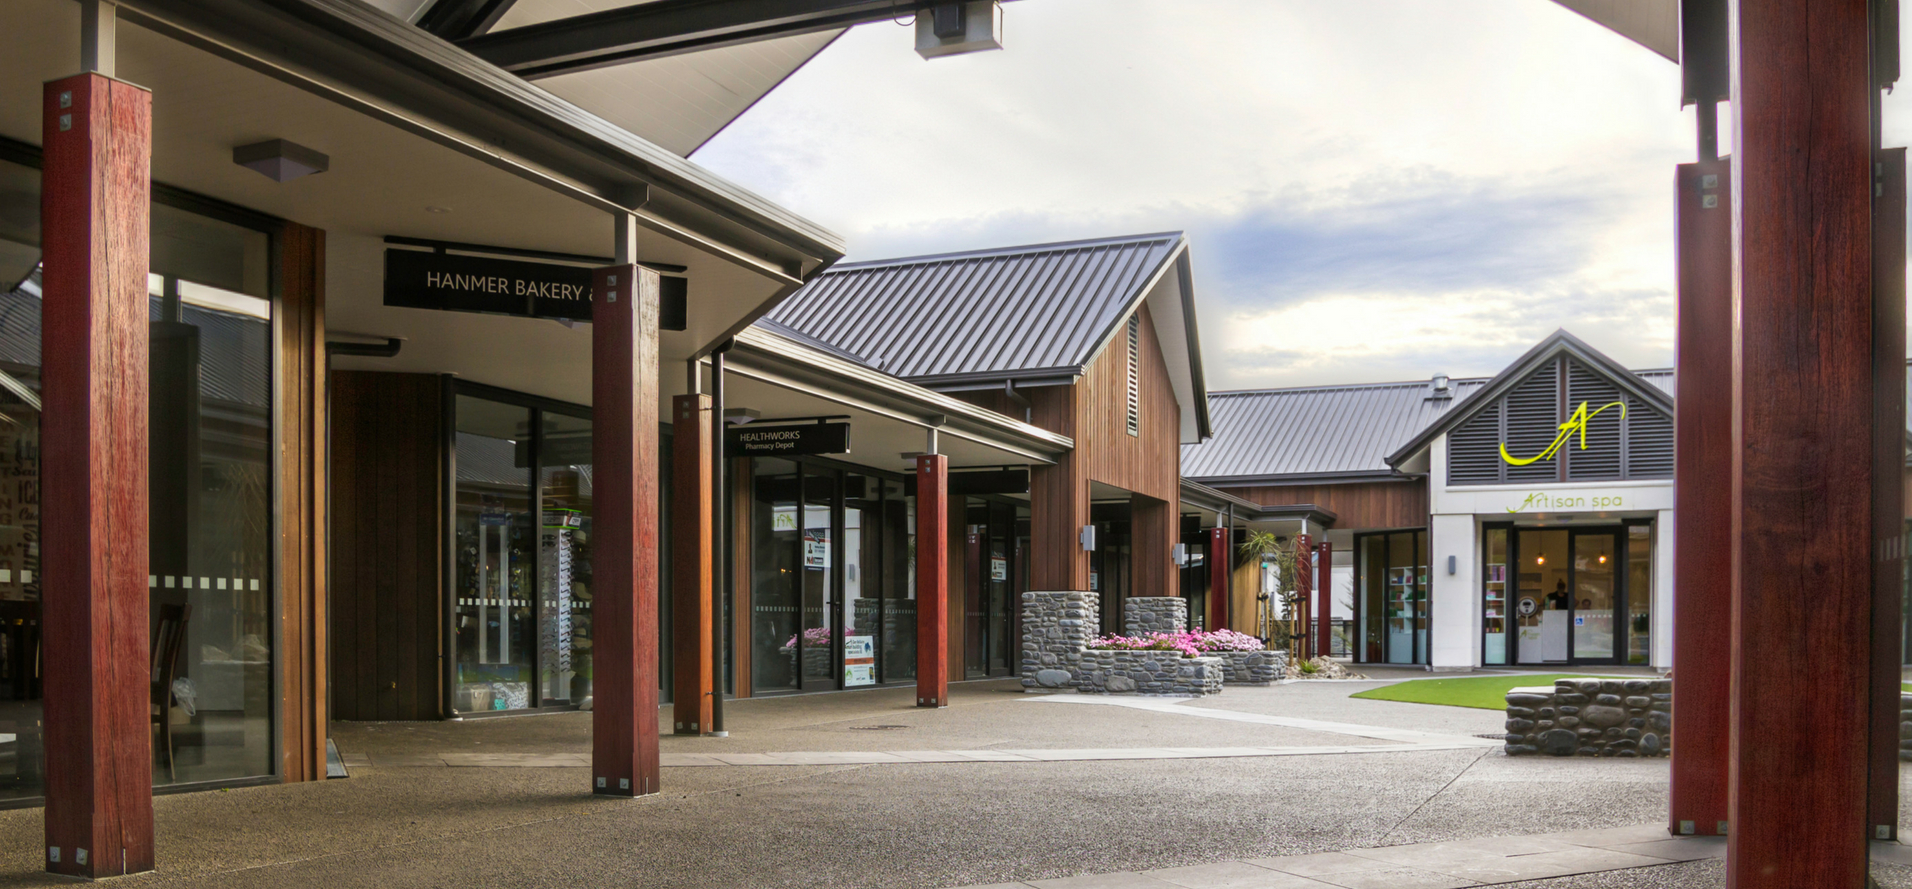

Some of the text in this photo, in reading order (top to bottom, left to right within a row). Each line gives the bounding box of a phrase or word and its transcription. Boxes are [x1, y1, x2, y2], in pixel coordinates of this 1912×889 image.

[427, 271, 510, 295] HANMER
[515, 279, 583, 301] BAKERY
[740, 430, 800, 442] HEALTHWORKS
[1500, 400, 1626, 466] A
[745, 441, 795, 450] Pharmacy Depot
[1506, 492, 1623, 513] Artisan spa
